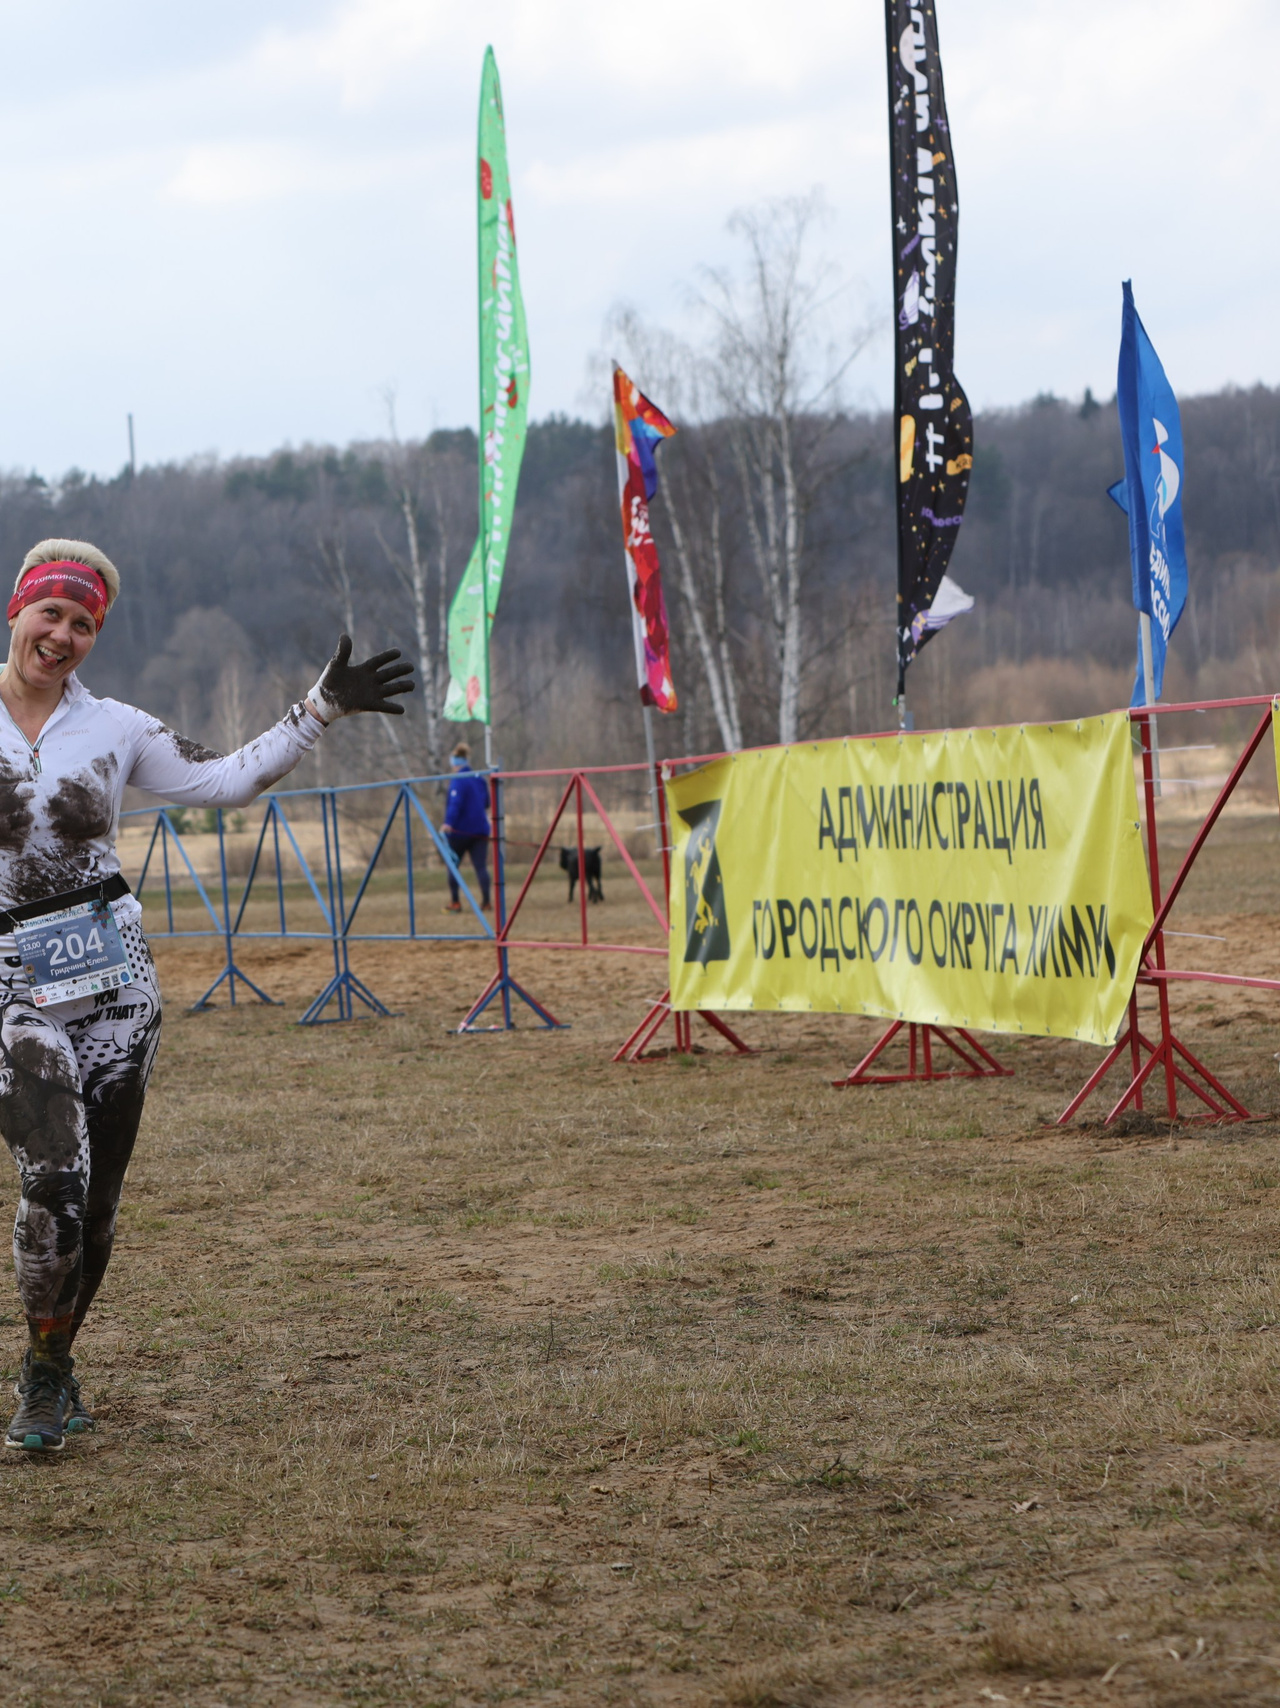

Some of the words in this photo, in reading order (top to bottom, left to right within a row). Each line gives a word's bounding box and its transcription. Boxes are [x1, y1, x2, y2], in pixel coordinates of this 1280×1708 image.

[818, 776, 1047, 866] АДМИНИСТРАЦИЯ
[45, 927, 105, 966] 204
[753, 896, 923, 973] ГОРОДСКОГО
[928, 898, 1020, 976] ОКРУГА
[50, 962, 85, 977] Гридчина
[86, 955, 109, 967] Елена
